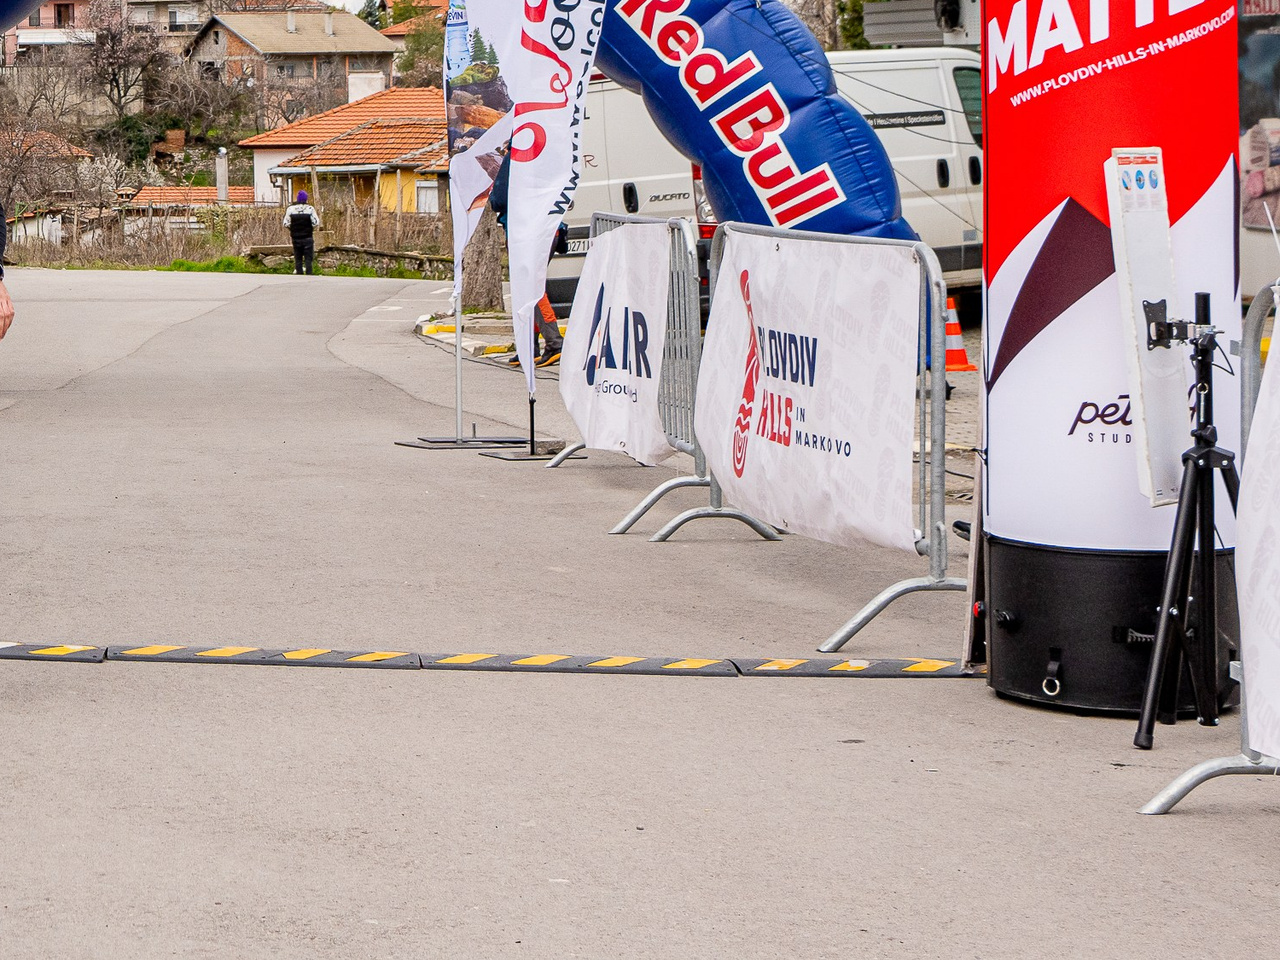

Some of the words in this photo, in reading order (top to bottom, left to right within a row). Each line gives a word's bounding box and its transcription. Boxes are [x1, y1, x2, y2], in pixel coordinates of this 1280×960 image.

[1009, 4, 1236, 107] WWW.PLOVDIV-HILLS-IN-MARKOVO.COM
[715, 87, 840, 228] Bull
[649, 192, 690, 202] DUCATO
[796, 406, 805, 422] IN
[795, 430, 851, 457] MARKOVO
[1087, 432, 1132, 444] STUD
